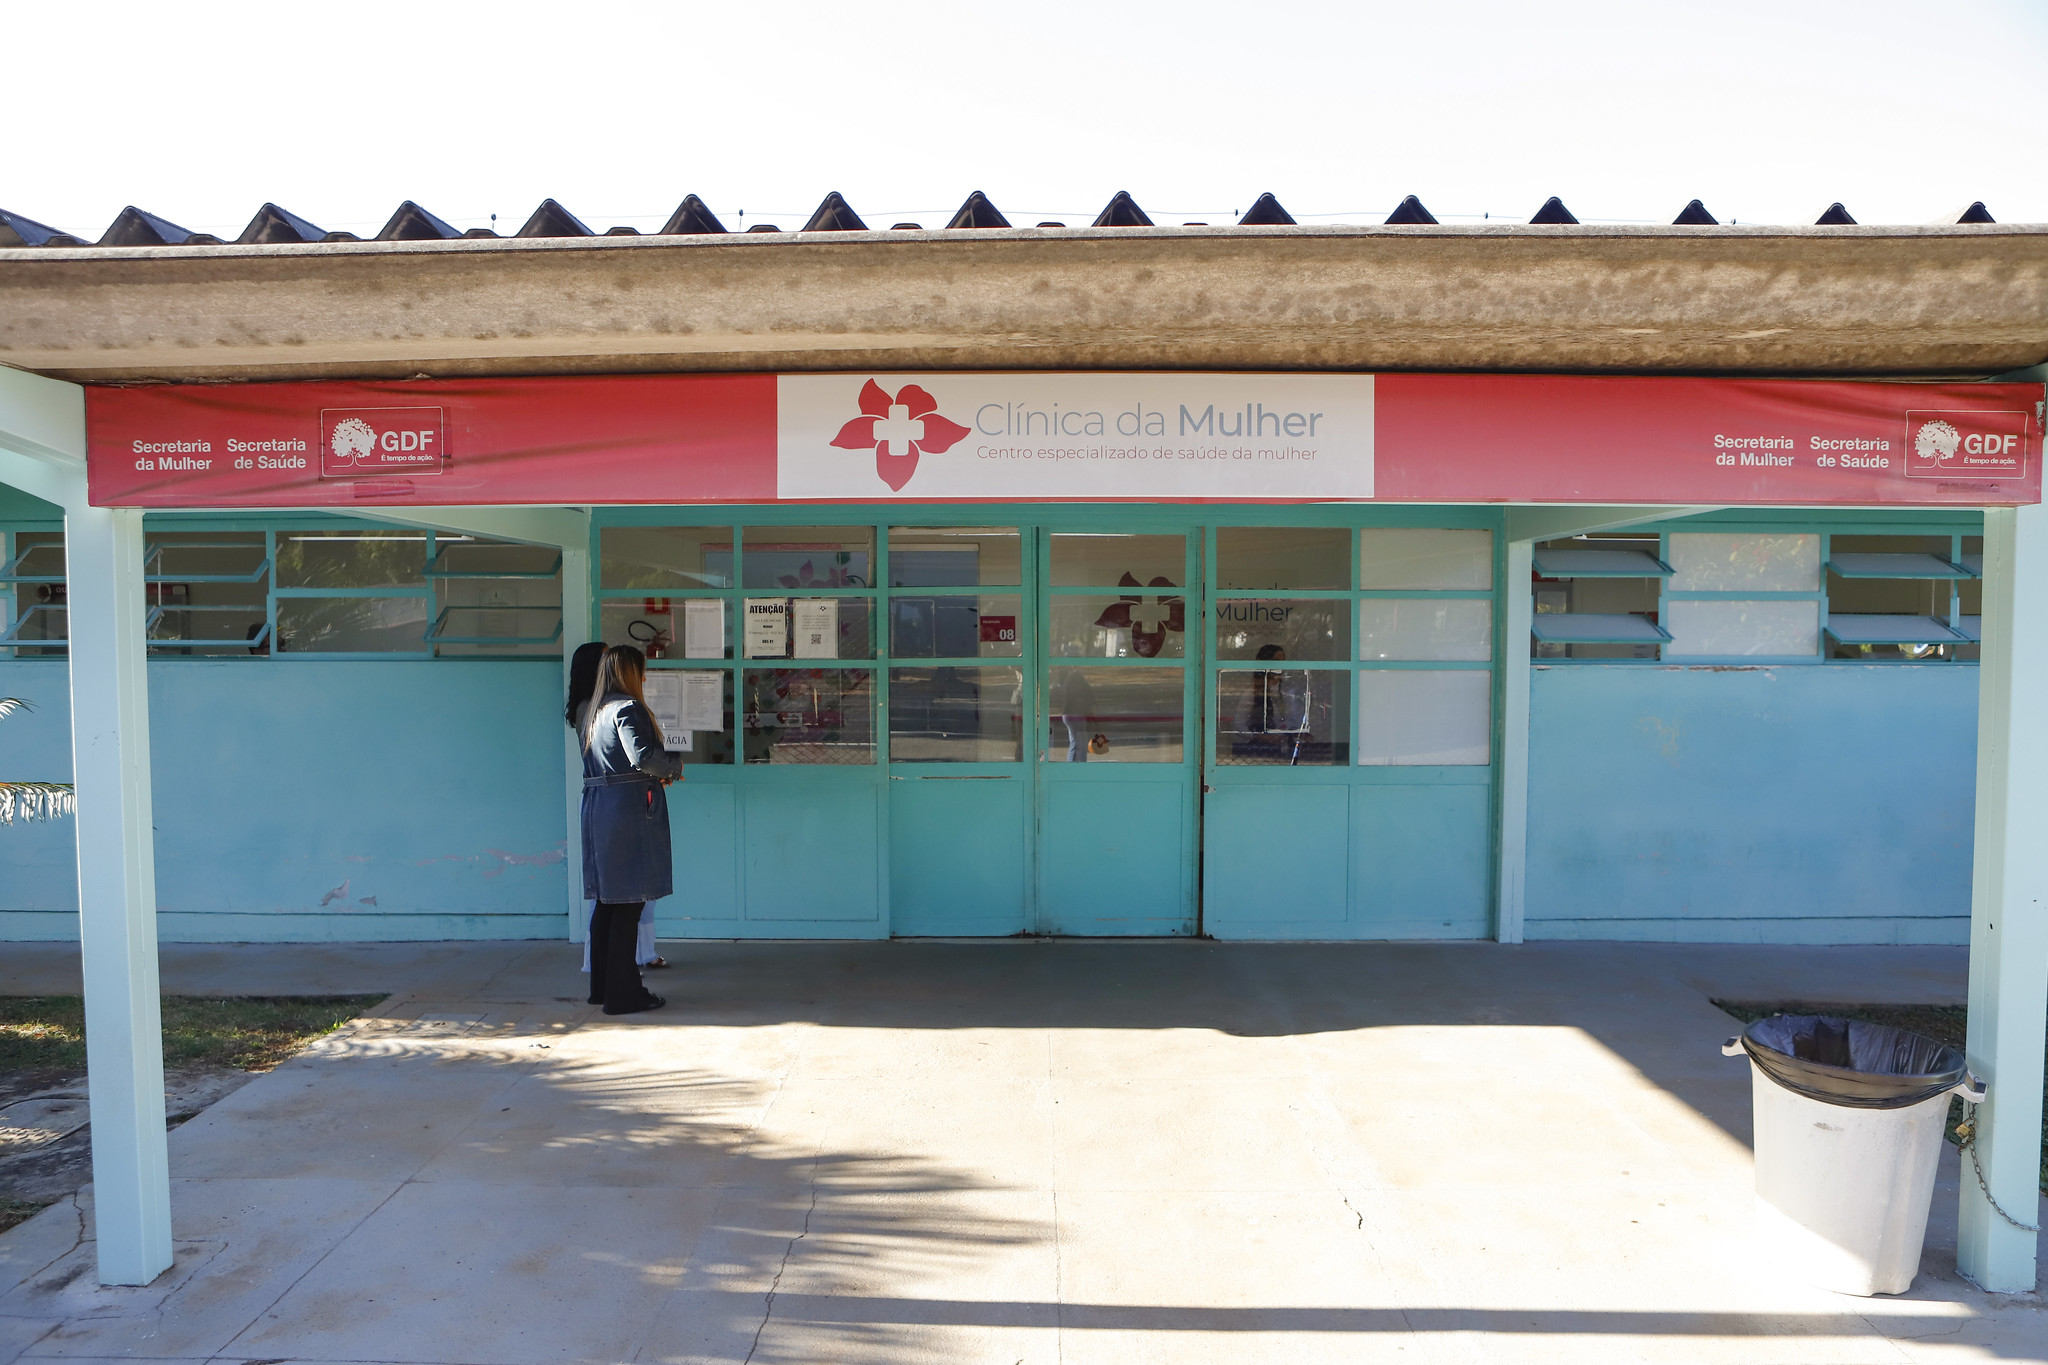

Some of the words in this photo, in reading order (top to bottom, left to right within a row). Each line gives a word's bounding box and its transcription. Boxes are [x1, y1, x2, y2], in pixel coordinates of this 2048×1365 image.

[976, 401, 1103, 436] Clínica
[1117, 402, 1164, 436] da
[1180, 402, 1324, 437] Mulher
[132, 439, 212, 454] Secretaria
[227, 437, 307, 453] Secretaria
[381, 430, 434, 452] GDF
[1713, 434, 1794, 450] Secretaria
[1809, 435, 1890, 451] Secretaria
[1964, 433, 2018, 455] GDF
[234, 455, 254, 470] de
[258, 453, 307, 470] Saúde
[380, 453, 386, 462] É
[387, 455, 407, 463] tempo
[408, 454, 416, 462] de
[416, 455, 435, 463] ação.
[976, 445, 1033, 459] Centro
[1038, 445, 1148, 462] especializado
[1153, 445, 1174, 459] de
[1178, 445, 1228, 460] saúde
[1233, 446, 1252, 460] da
[1258, 446, 1318, 461] mulher
[1715, 451, 1736, 466] da
[1740, 452, 1795, 467] Mulher
[1816, 453, 1836, 468] de
[1840, 453, 1890, 469] Saúde
[1963, 455, 1969, 464] É
[1970, 456, 1990, 465] tempo
[1990, 456, 1999, 465] de
[1999, 457, 2017, 465] ação.
[135, 457, 154, 471] da
[159, 456, 213, 471] Mulher
[749, 603, 784, 616] ATENÇÃO
[1216, 602, 1294, 622] Mulher
[999, 628, 1015, 641] 08
